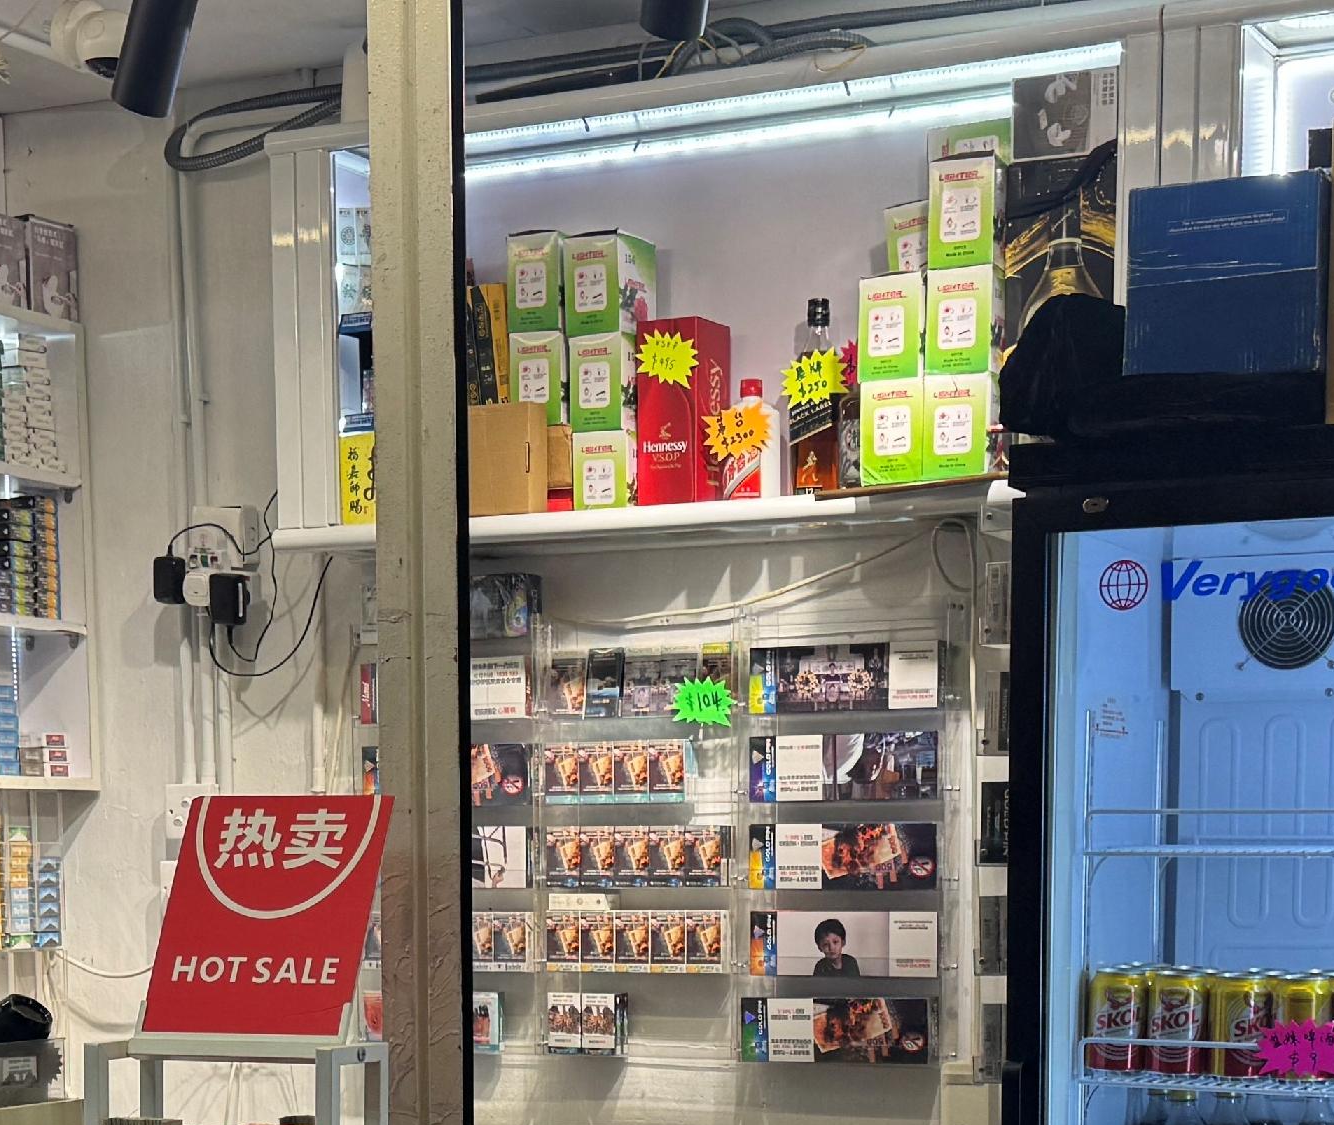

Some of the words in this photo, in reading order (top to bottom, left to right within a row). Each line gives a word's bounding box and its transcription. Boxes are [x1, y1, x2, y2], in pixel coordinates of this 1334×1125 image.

[642, 440, 688, 454] Hennessy
[214, 808, 348, 869] 热卖
[171, 956, 247, 982] HOT
[252, 958, 340, 985] SALE
[1095, 1006, 1142, 1030] SKOL
[1152, 1013, 1200, 1034] SKOL
